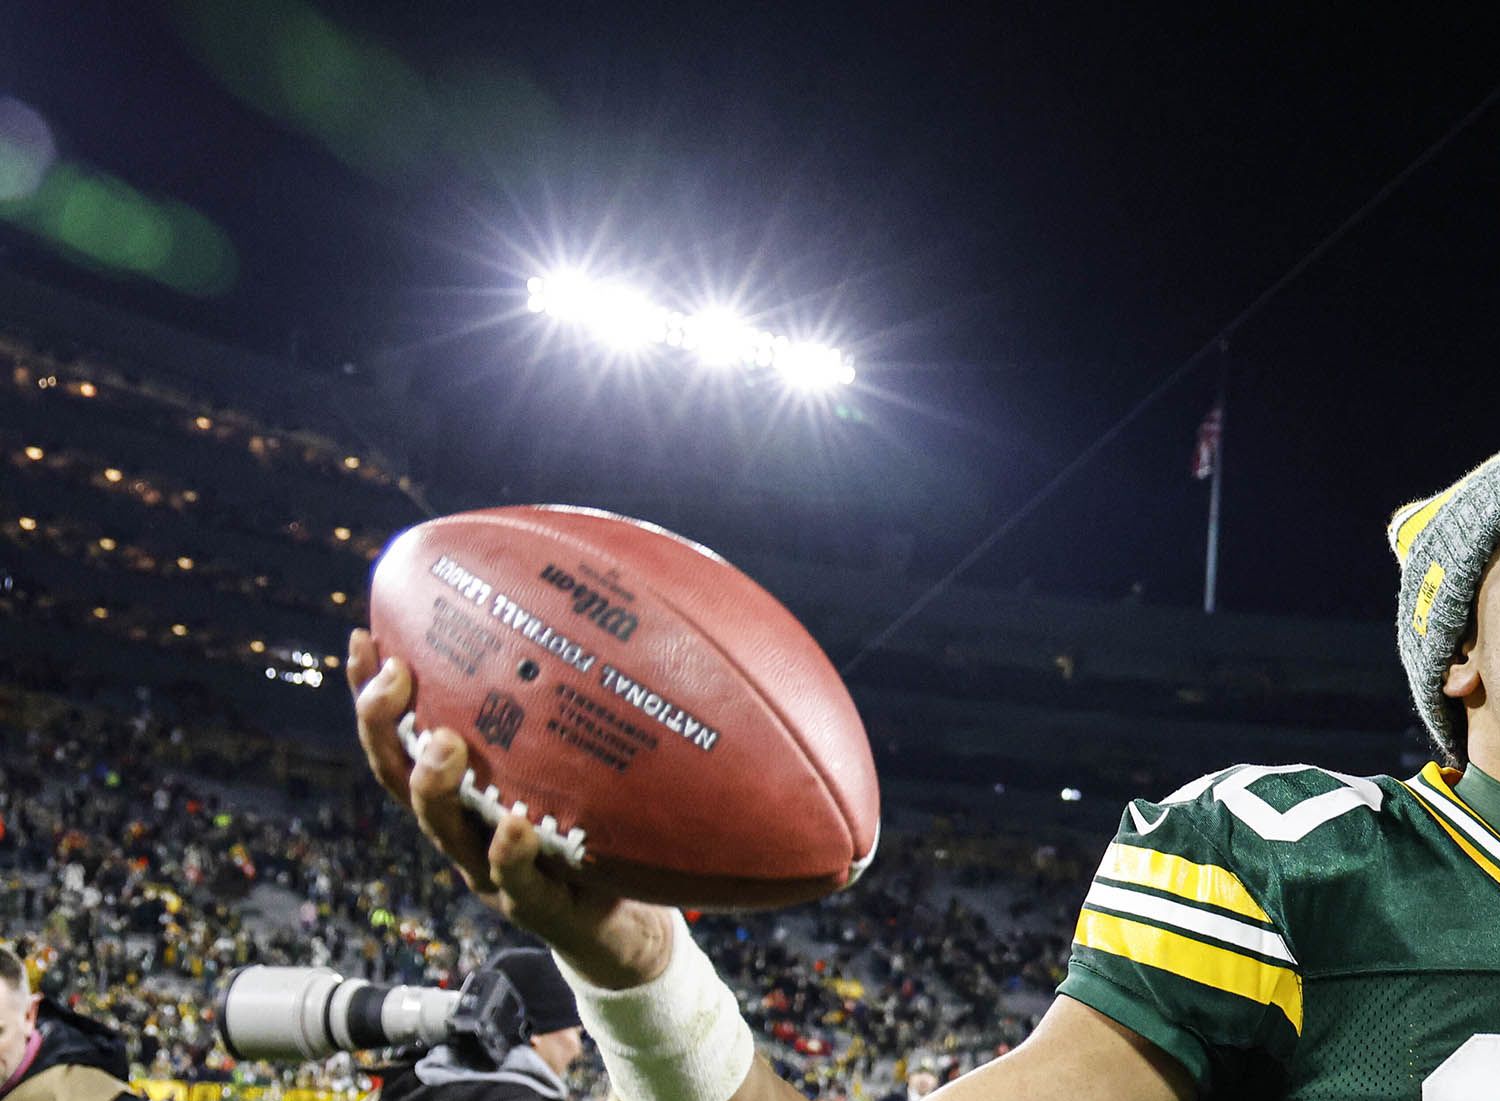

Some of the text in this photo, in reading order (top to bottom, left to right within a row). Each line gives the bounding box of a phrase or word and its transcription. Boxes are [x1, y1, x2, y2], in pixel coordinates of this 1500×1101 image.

[430, 556, 492, 605] LEAGUE
[540, 563, 640, 643] Wilson
[491, 594, 597, 672] FOOTBALL
[601, 664, 720, 751] NATIONAL
